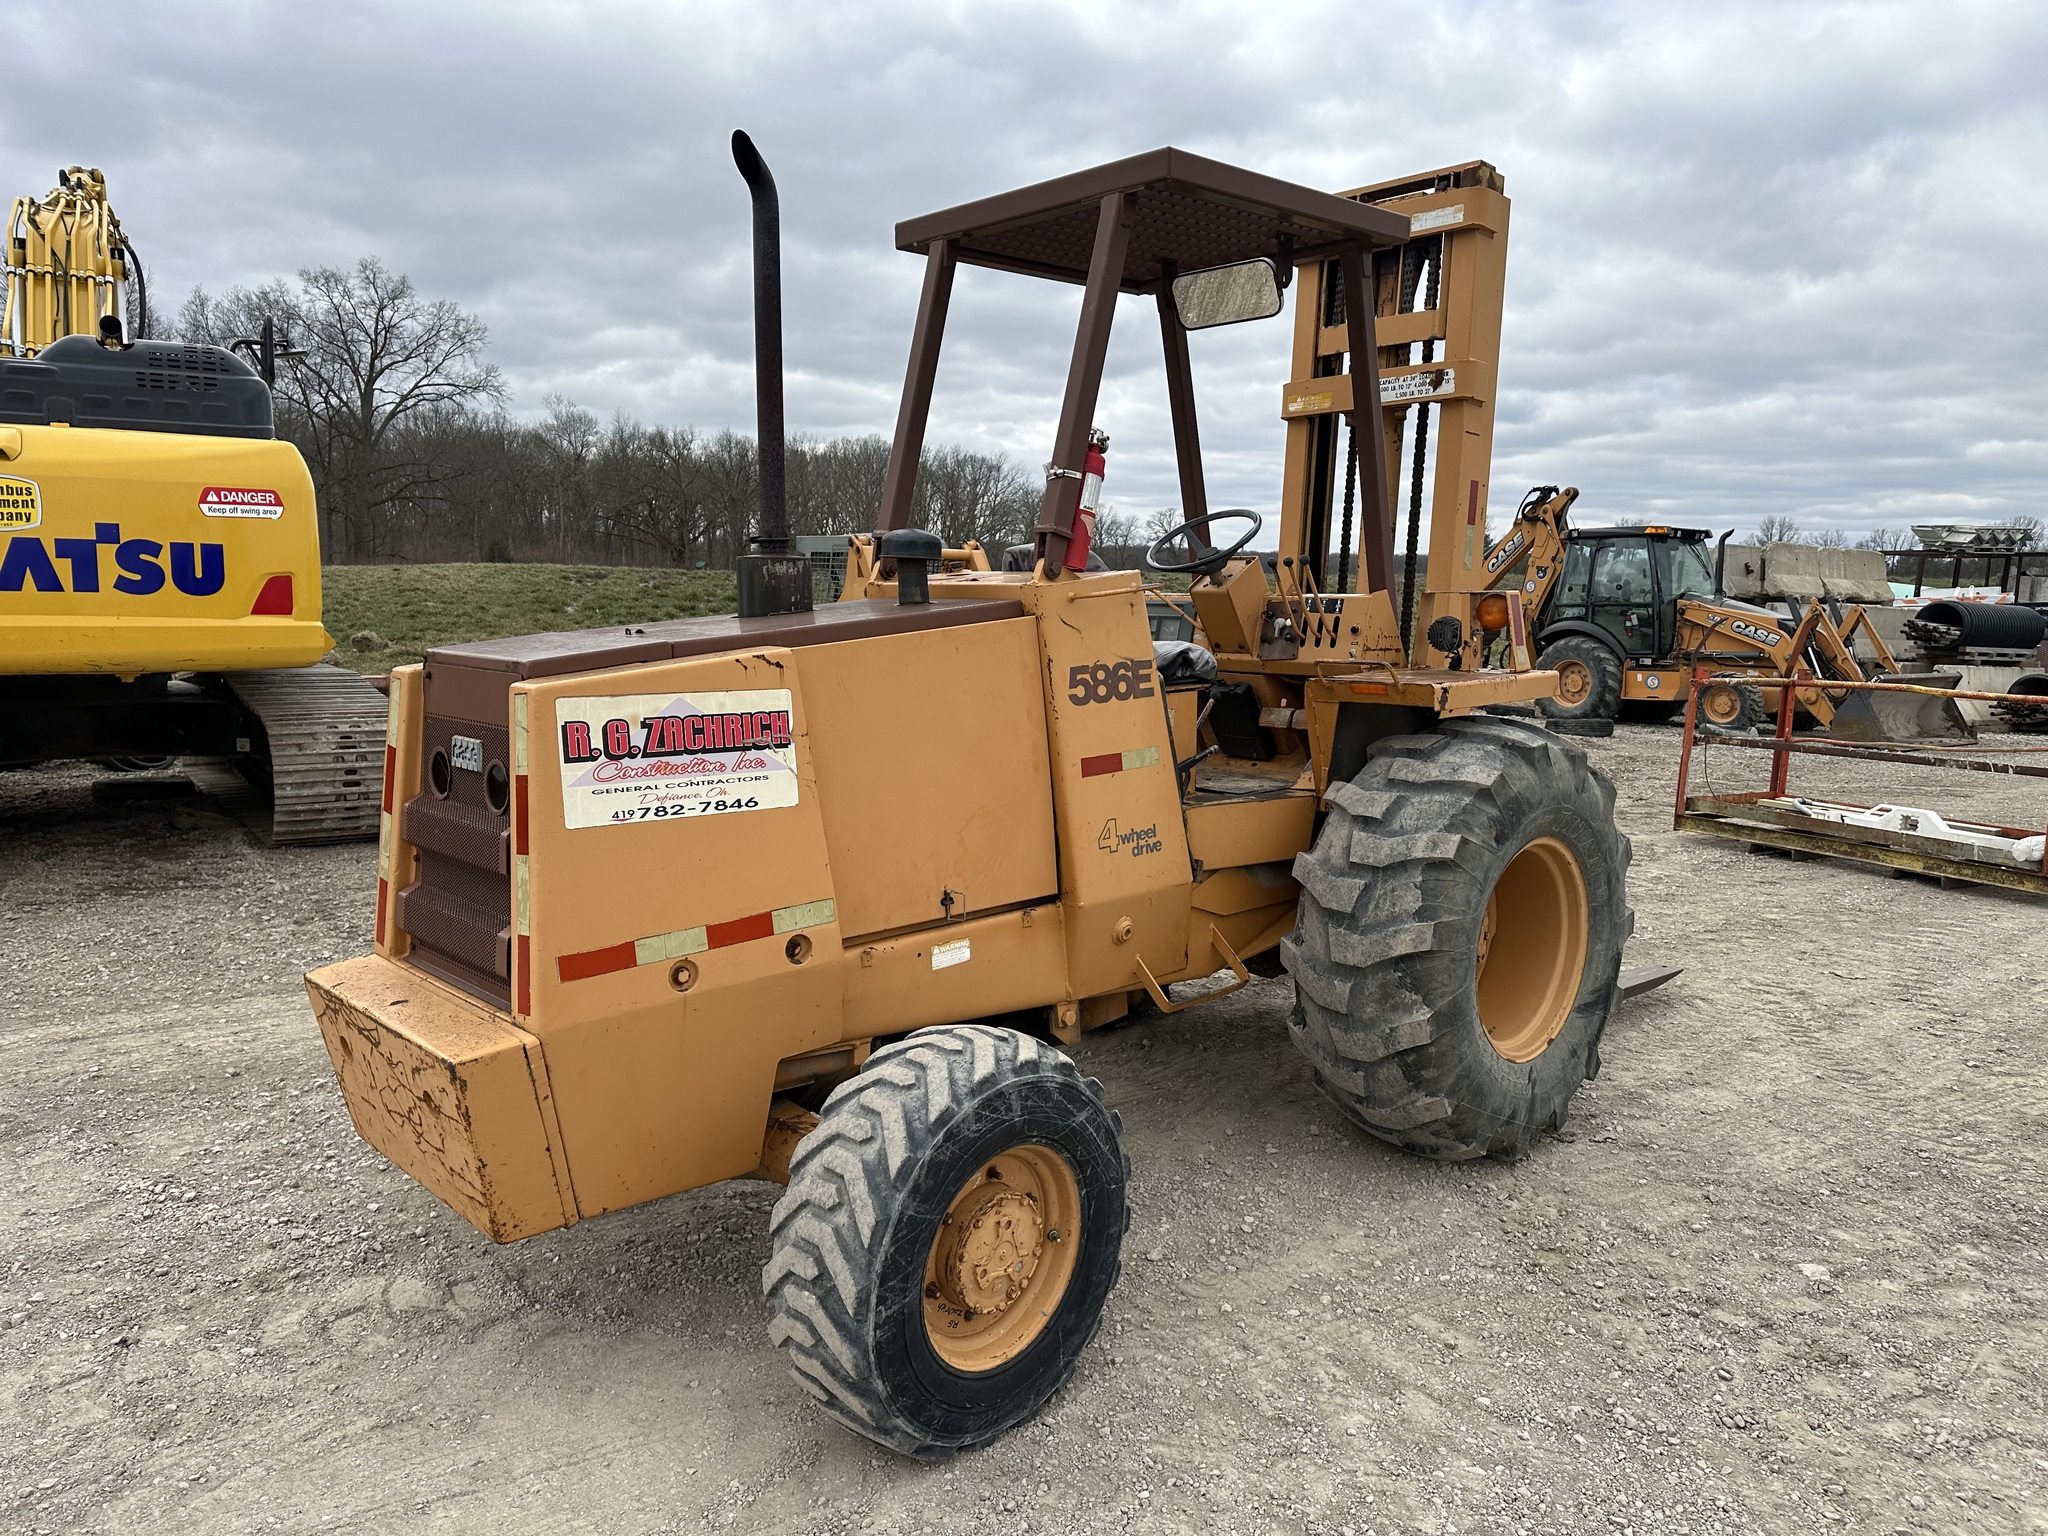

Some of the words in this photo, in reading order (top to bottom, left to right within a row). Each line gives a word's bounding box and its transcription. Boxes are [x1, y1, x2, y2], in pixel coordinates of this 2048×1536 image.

[221, 490, 275, 505] DANGER
[208, 505, 226, 516] Keep
[228, 506, 239, 515] off
[240, 507, 261, 517] swing
[261, 508, 278, 516] area
[1488, 529, 1525, 573] CASE
[1731, 619, 1783, 648] CASE
[1068, 660, 1154, 706] 586E
[640, 710, 791, 758] ZACHRICH
[593, 757, 727, 783] Construction,
[731, 751, 768, 771] Inc.
[591, 783, 662, 796] GENERAL
[665, 775, 770, 790] CONTRACTORS
[611, 809, 636, 821] 419
[638, 797, 760, 820] 782-7846
[637, 792, 703, 806] Defiance,
[1097, 817, 1121, 854] 4
[1120, 823, 1157, 845] wheel
[1131, 839, 1163, 858] drive
[1552, 812, 1604, 876] TITAN
[939, 938, 970, 953] WARNING
